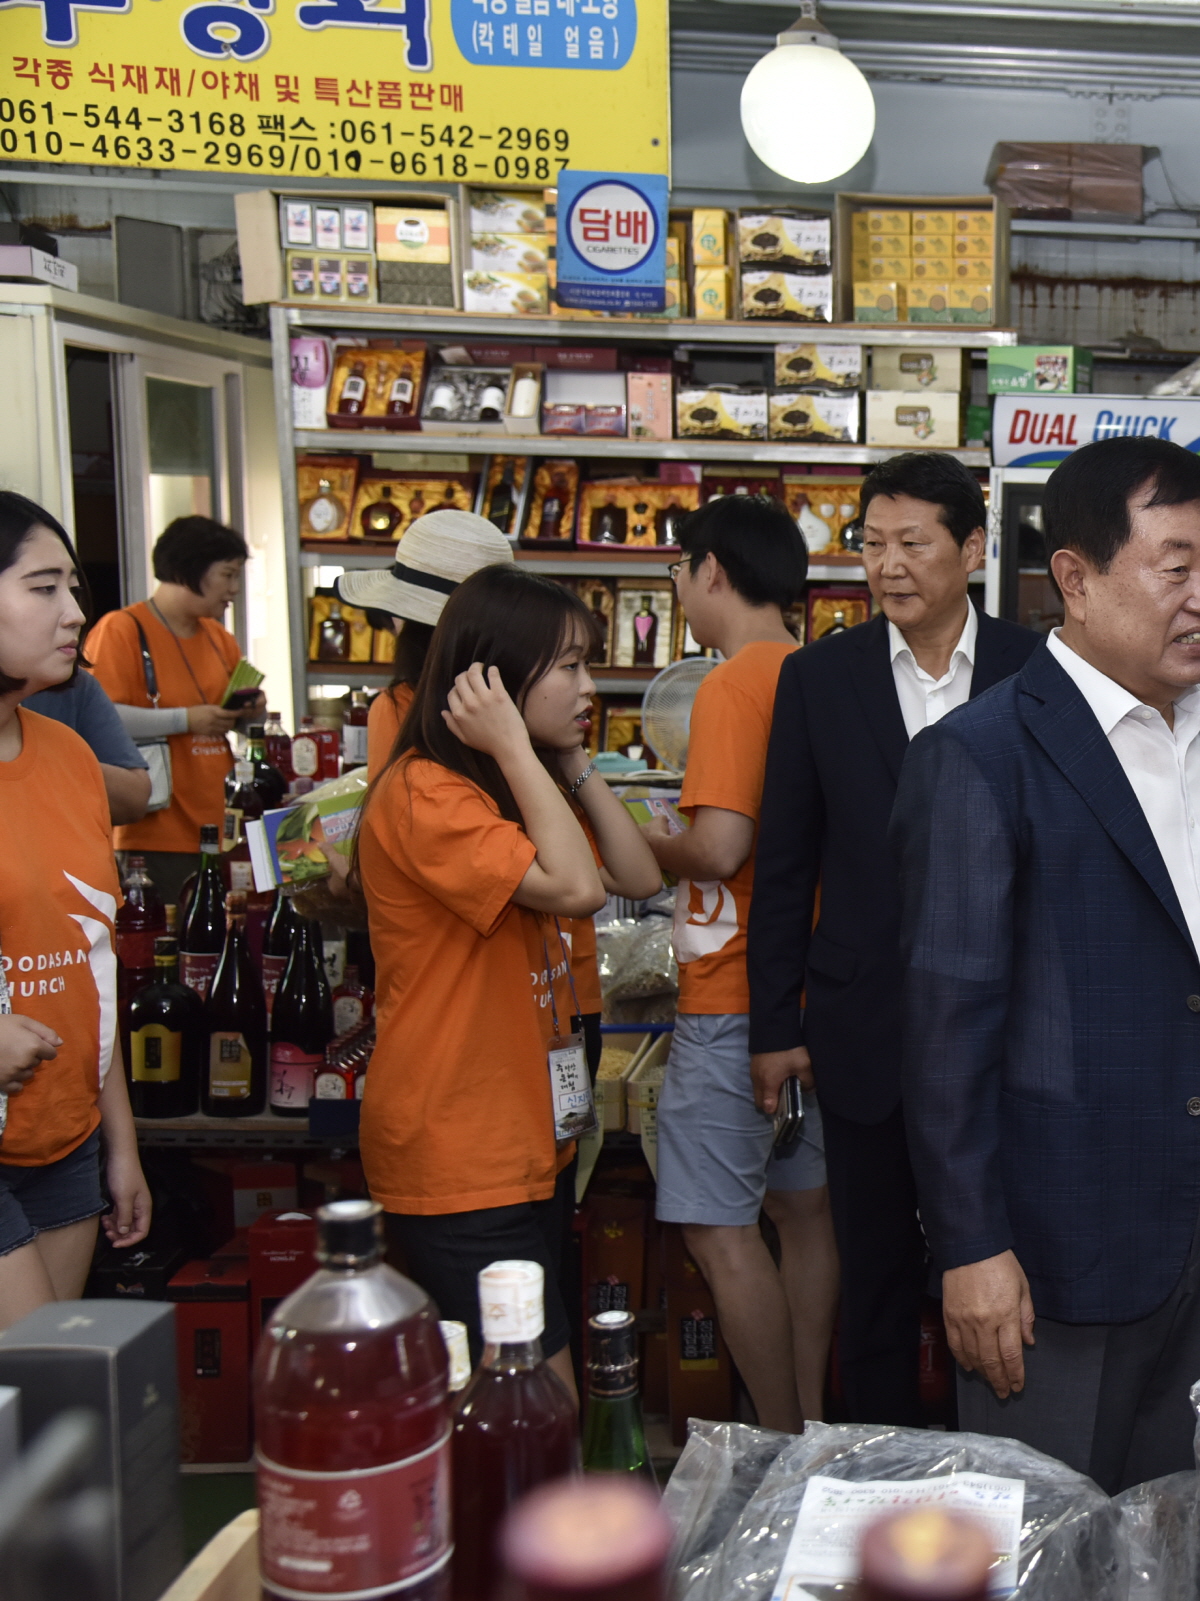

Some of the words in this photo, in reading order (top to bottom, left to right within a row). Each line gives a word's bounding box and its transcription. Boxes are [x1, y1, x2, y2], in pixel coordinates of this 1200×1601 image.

[564, 26, 619, 60] 얼음)
[13, 56, 73, 90] 각종
[88, 62, 260, 102] 식재재/야채
[274, 74, 300, 104] 및
[314, 77, 464, 113] 특산품판매
[0, 97, 246, 137] 061-544-3168
[257, 114, 318, 142] 팩스
[579, 207, 648, 245] 담배
[586, 245, 640, 255] CIGARETTES
[1008, 408, 1079, 446] DUAL
[1092, 409, 1179, 441] QUICK
[0, 949, 87, 972] OODASAN
[8, 976, 66, 998] HURCH
